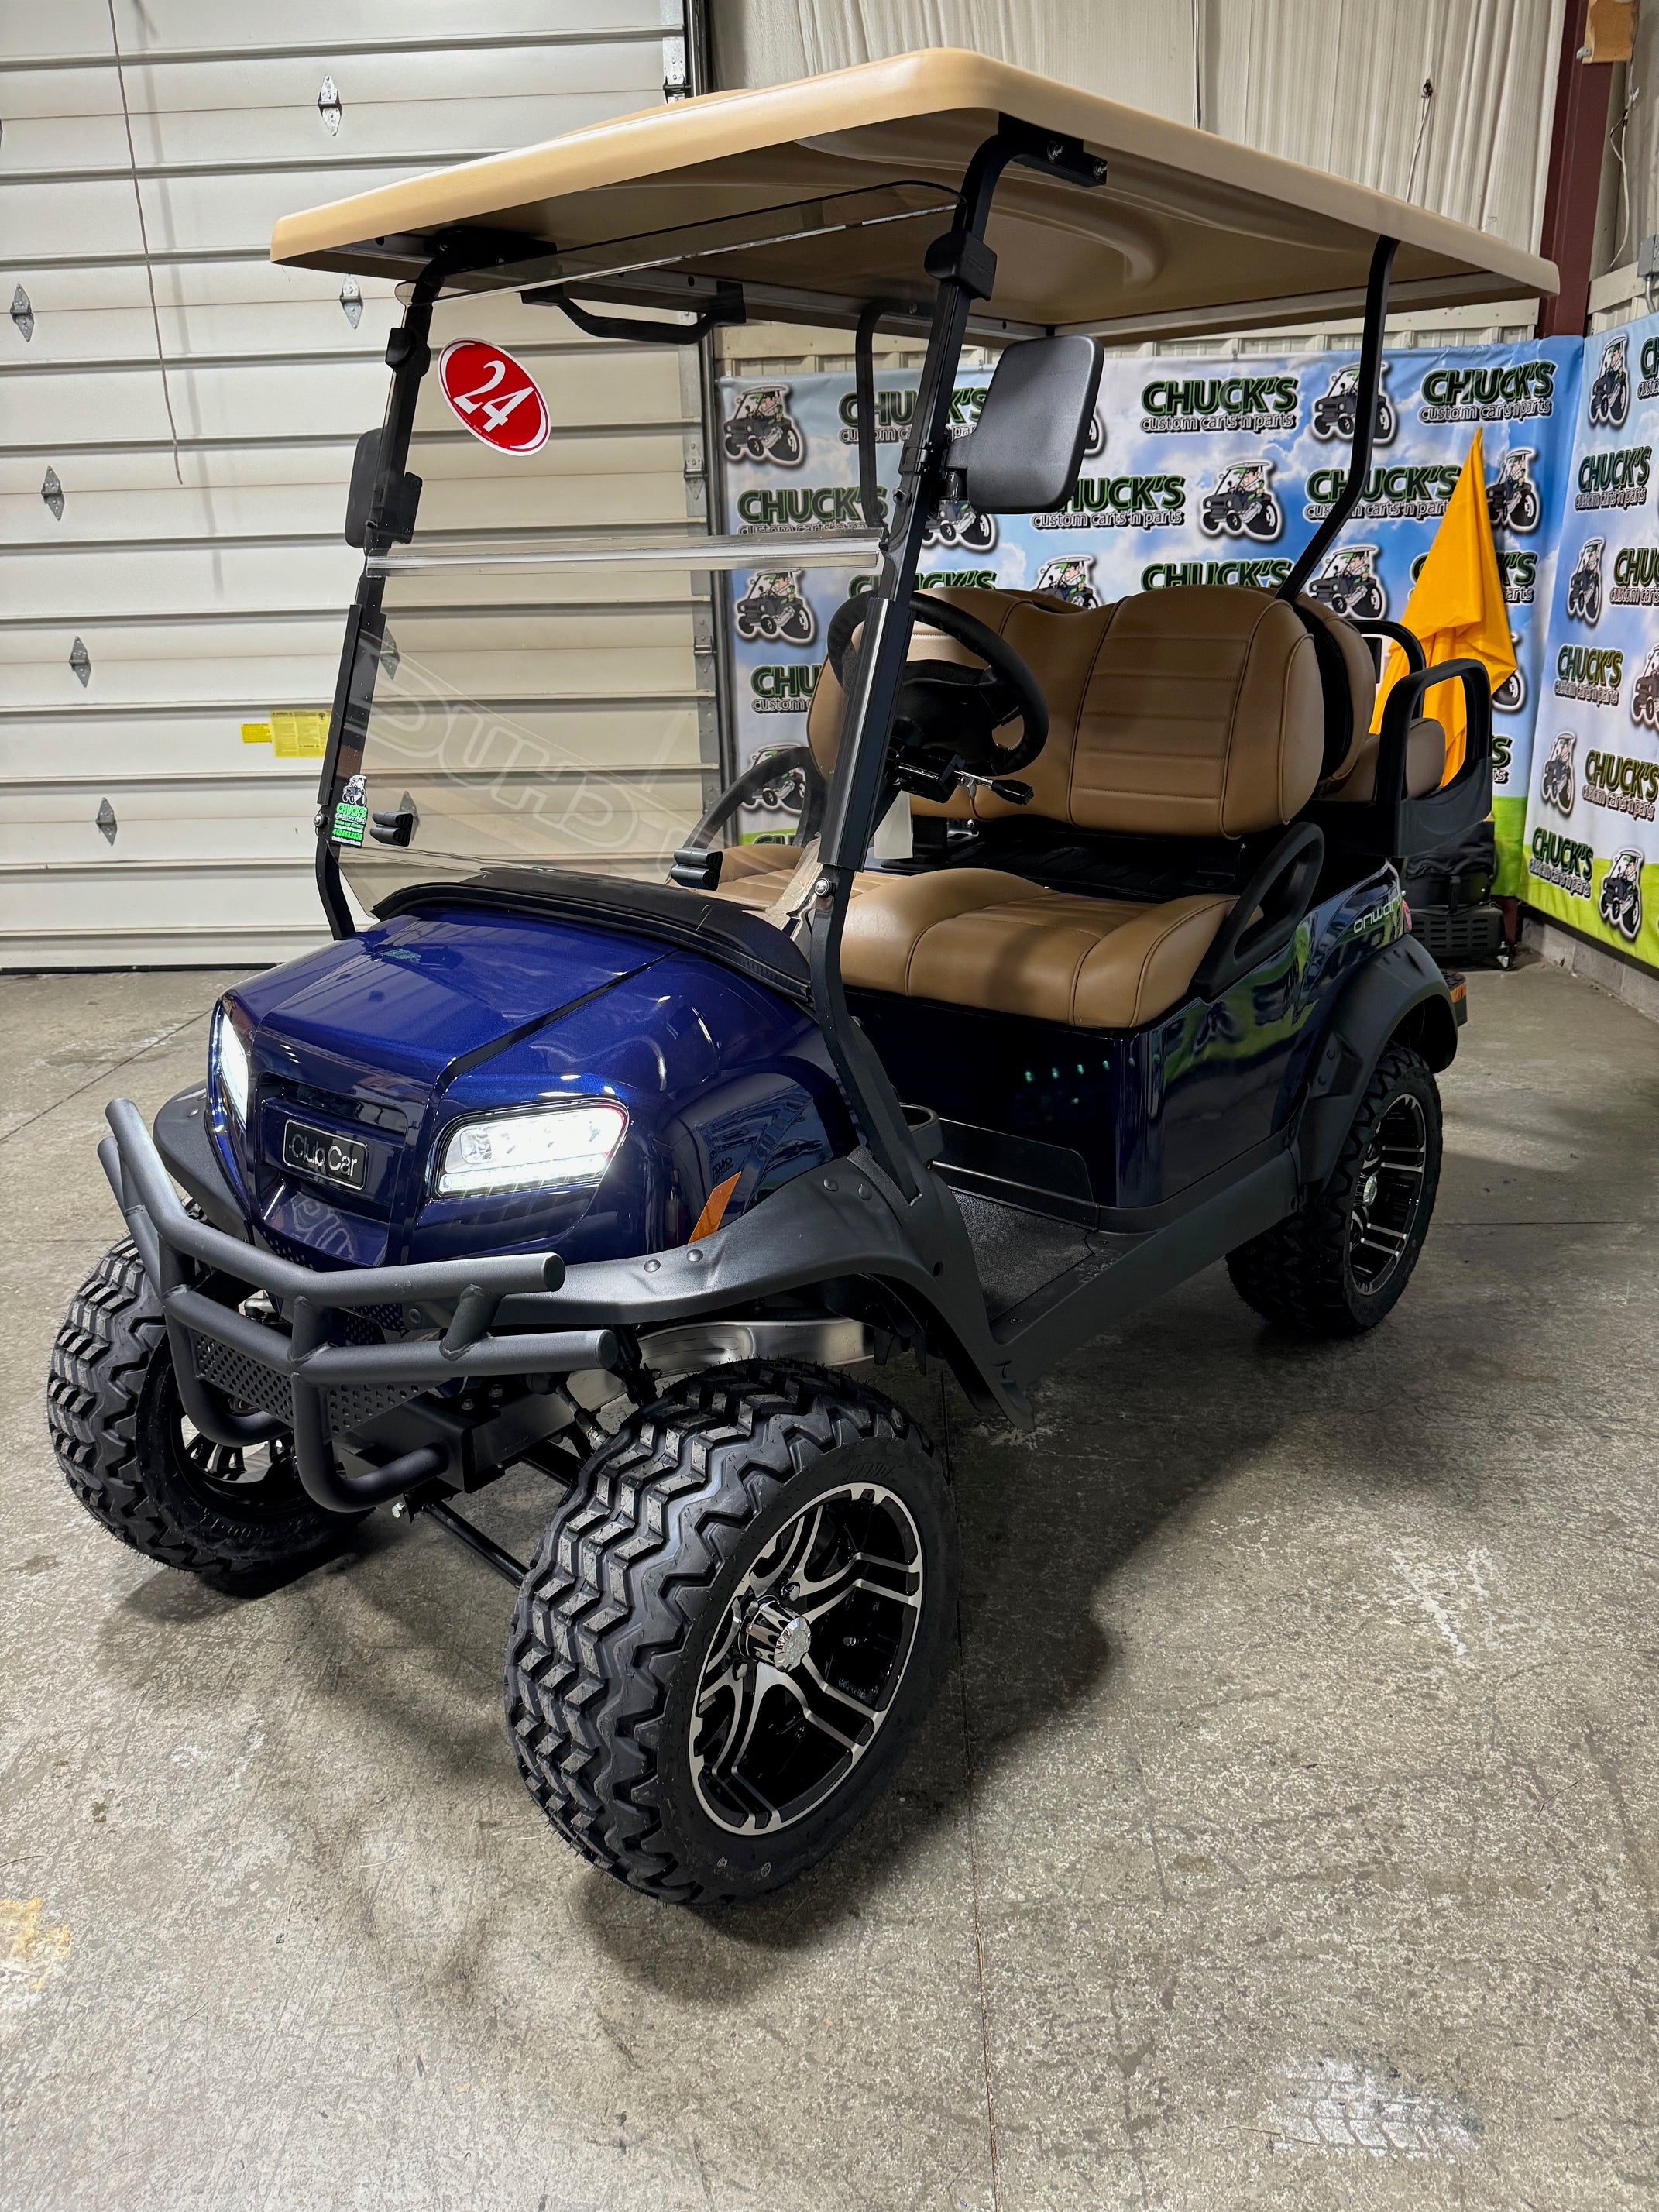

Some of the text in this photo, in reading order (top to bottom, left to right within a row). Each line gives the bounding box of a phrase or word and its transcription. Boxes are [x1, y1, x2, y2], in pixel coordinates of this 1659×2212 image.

[452, 359, 534, 433] 24
[1141, 376, 1298, 416] CHUCK'S
[1421, 360, 1556, 406] CHUCK'S
[838, 387, 988, 427] CHUK'S
[1140, 415, 1200, 433] custom
[1254, 412, 1297, 434] parts
[1419, 404, 1479, 424] custom
[1519, 398, 1552, 422] parts
[1578, 445, 1652, 493] CHUCK'S
[1059, 475, 1185, 512] HUCK'S
[1417, 500, 1450, 521] part
[1032, 512, 1090, 529] custom
[1142, 509, 1184, 530] parts
[1141, 559, 1293, 591] CHUCK'S
[1558, 645, 1623, 688] CHUCK'S
[751, 698, 807, 713] custom
[1585, 749, 1659, 802] CHUCK'S
[1532, 826, 1593, 881] CHUCK'S
[291, 1133, 358, 1176] Club Car
